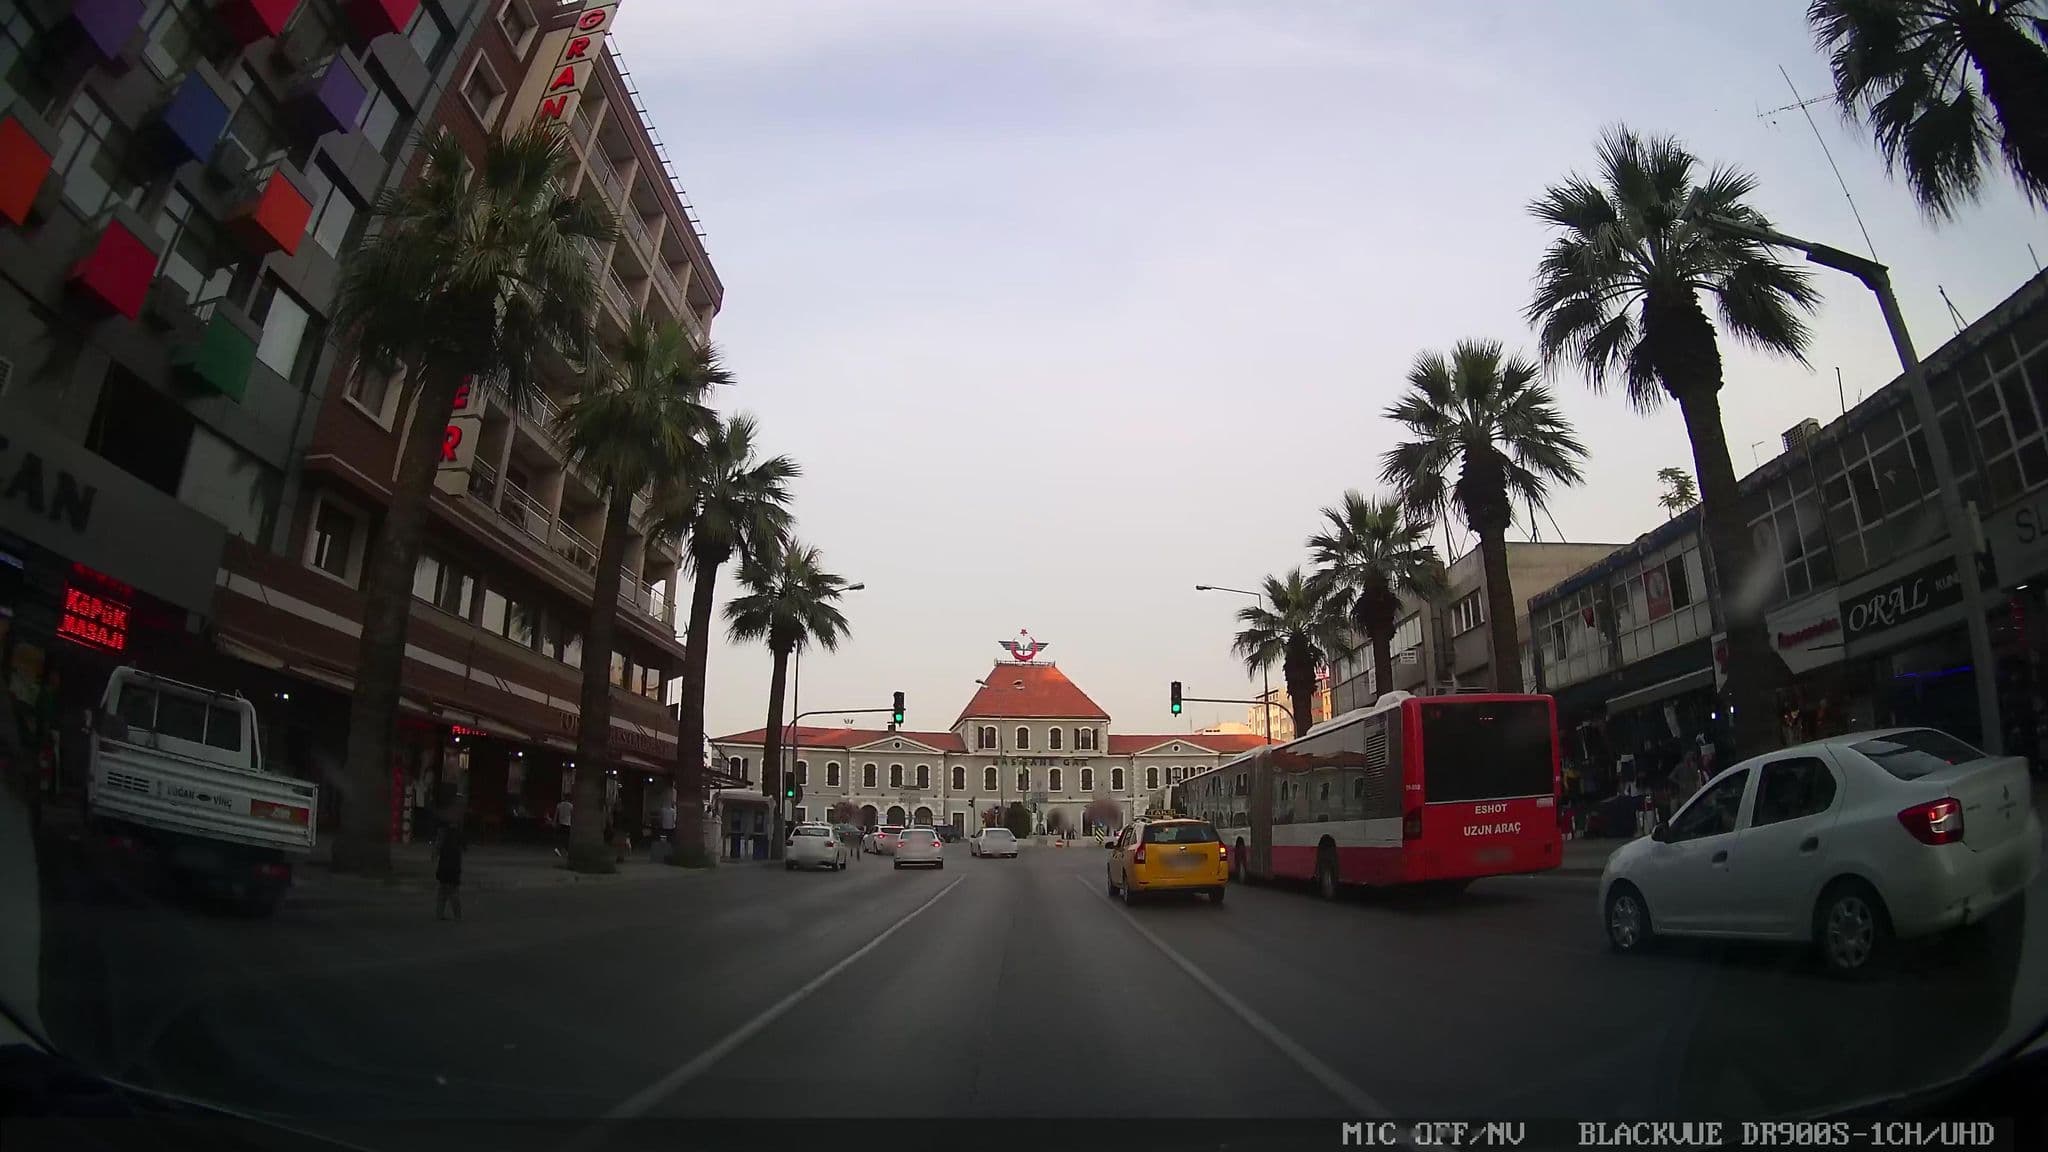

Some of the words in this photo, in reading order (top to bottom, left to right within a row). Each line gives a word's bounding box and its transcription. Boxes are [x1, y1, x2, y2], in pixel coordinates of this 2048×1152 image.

[539, 8, 606, 121] GRAN
[0, 436, 98, 534] AN
[1848, 577, 1929, 632] ORAL
[1463, 823, 1492, 837] UZUN
[1494, 821, 1521, 835] ARAÇ
[1474, 803, 1508, 815] ESHOT
